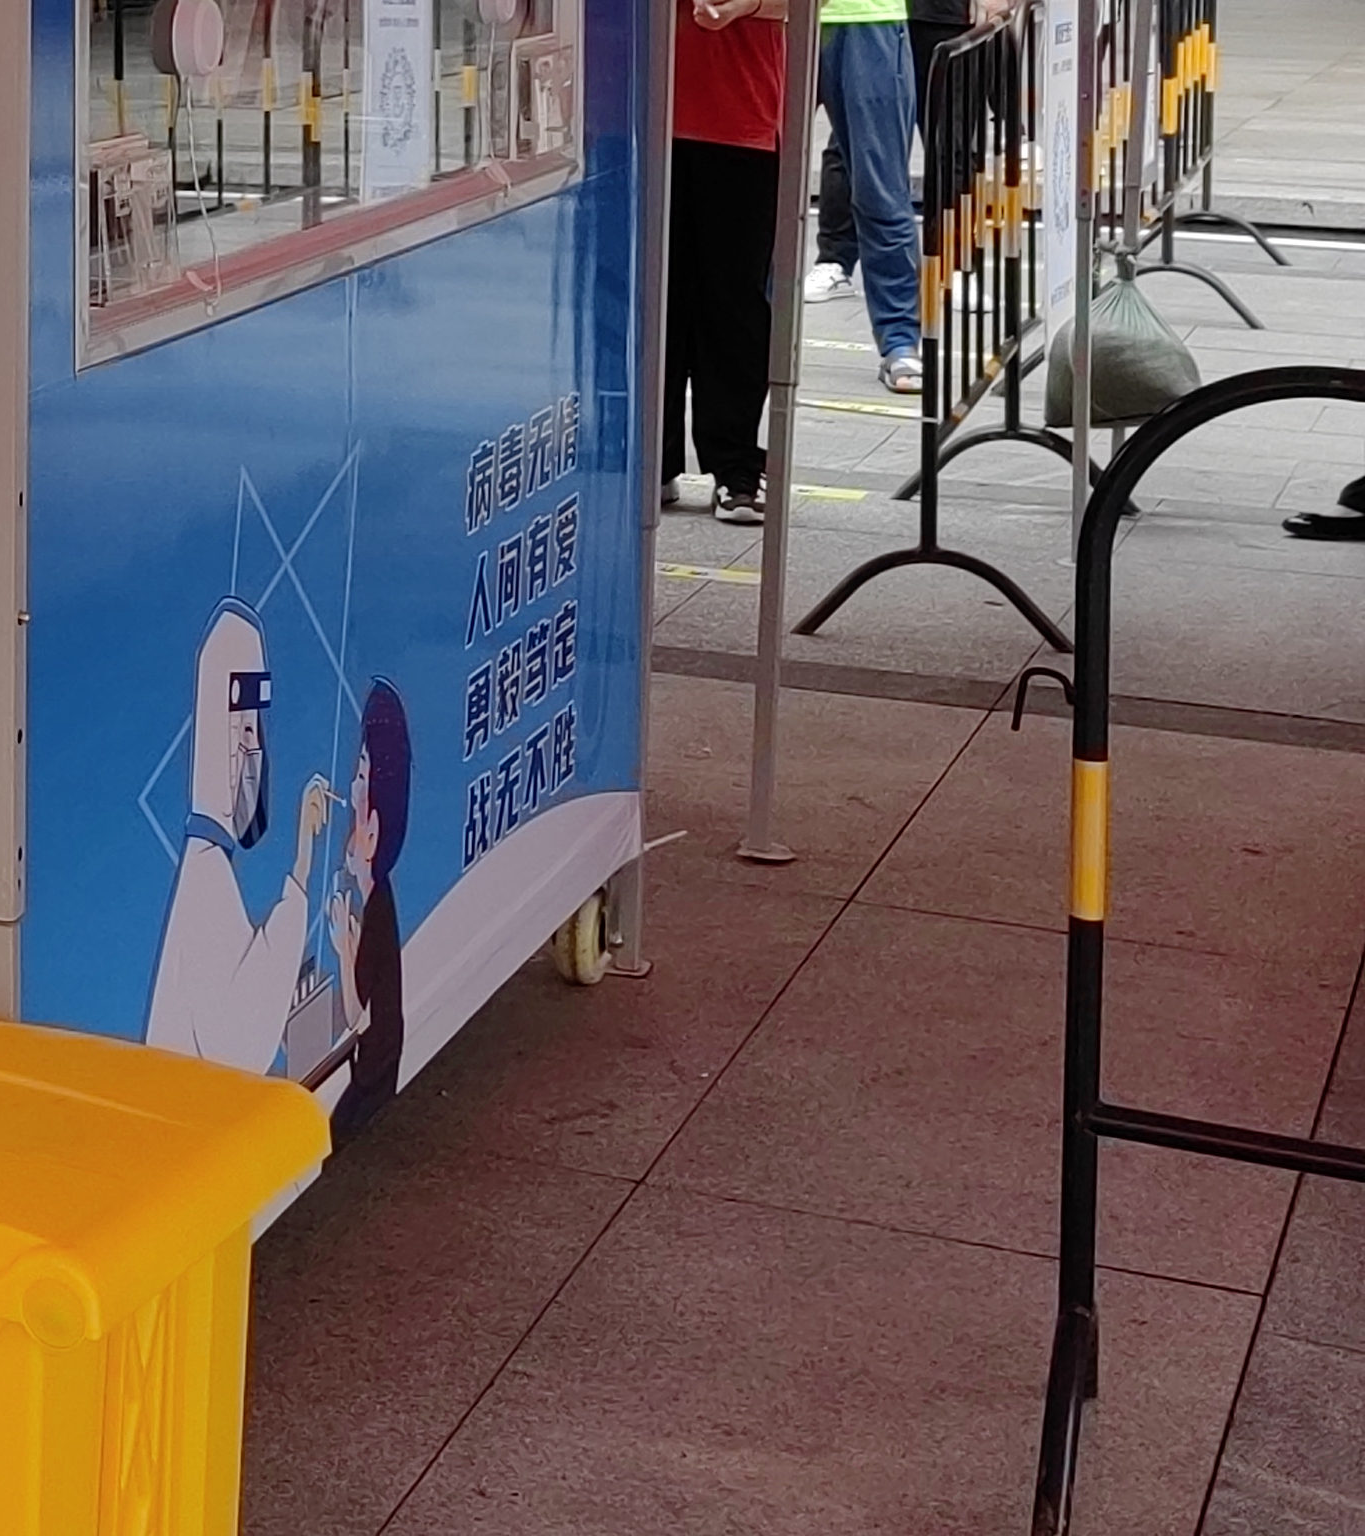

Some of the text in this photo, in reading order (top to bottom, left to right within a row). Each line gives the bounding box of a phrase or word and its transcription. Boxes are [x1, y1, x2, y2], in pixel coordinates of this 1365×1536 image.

[465, 391, 580, 535] 病毒无情
[464, 491, 580, 651] 人间有爱
[462, 600, 579, 763] 勇毅笃定
[460, 699, 577, 873] 战无不胜
